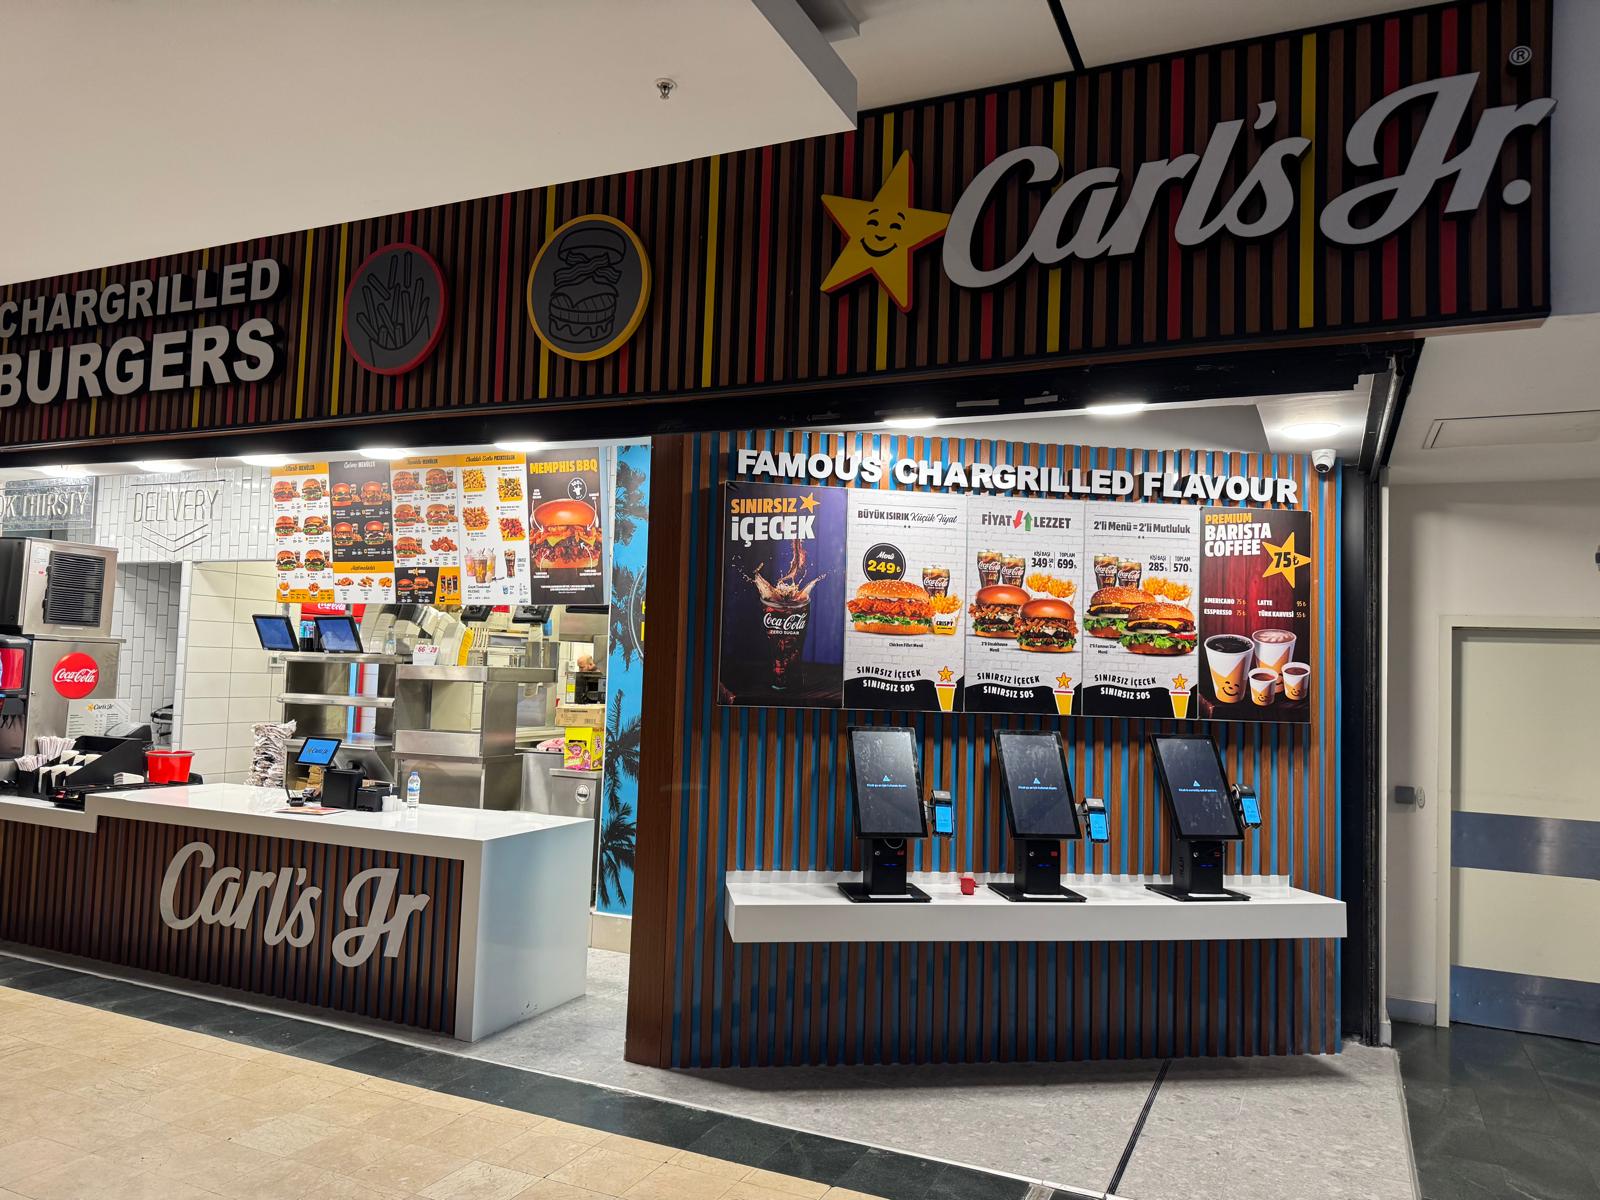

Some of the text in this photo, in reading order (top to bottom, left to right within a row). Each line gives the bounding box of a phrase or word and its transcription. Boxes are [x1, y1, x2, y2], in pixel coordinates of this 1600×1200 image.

[942, 71, 1558, 288] Carl's Jr.
[0, 258, 280, 338] CHARGRILLED
[0, 318, 275, 407] BURGERS
[530, 460, 576, 474] MEMPHIS
[577, 458, 598, 472] BBQ
[738, 449, 1298, 504] FAMOUS CHARGRILLED FLAVOUR
[134, 488, 219, 522] DELIVERY
[731, 498, 797, 514] SINIRSIZ
[858, 508, 958, 525] BÜYÜK ISIRIK Küçük Fiyat
[981, 512, 1071, 529] FİYAT LEZZET
[1205, 512, 1252, 524] PREMIUM
[1094, 521, 1107, 530] 2'li
[1108, 522, 1131, 532] Menü
[1139, 522, 1152, 532] 2'li
[1153, 524, 1190, 534] Mutluluk
[1205, 522, 1272, 540] BARISTA
[1204, 539, 1260, 557] COFFEE
[1032, 558, 1047, 568] 349
[764, 612, 807, 630] Coca-Cola
[54, 668, 98, 683] Coca-Cola
[856, 666, 922, 680] SINIRSIZ İÇECEK
[977, 672, 1040, 686] SINIRSIZ İÇECEK
[1094, 674, 1156, 687] SINIRSIZ İÇECEK
[862, 679, 915, 692] SINIRSIZ SOS
[984, 686, 1034, 698] SINIRSIZ SOS
[1100, 687, 1150, 700] SINIRSIZ SOS
[160, 842, 430, 967] Carl's Jr
